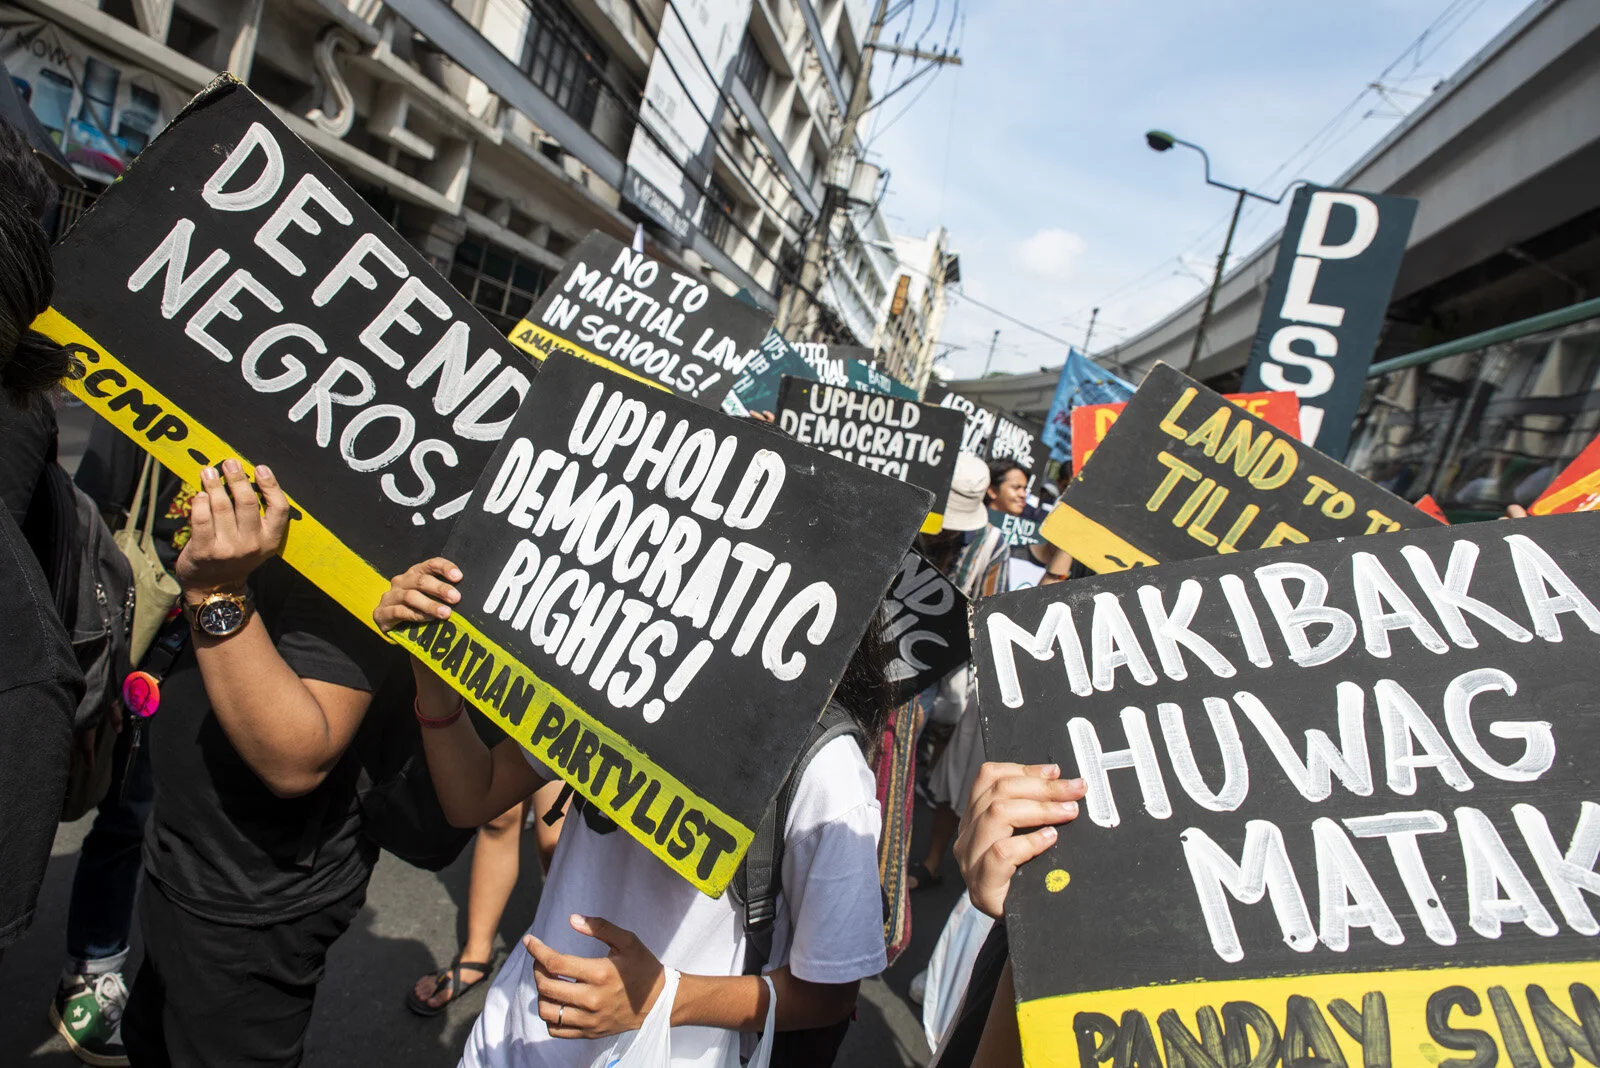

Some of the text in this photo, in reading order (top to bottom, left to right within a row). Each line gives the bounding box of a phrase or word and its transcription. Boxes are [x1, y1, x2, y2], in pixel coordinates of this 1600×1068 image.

[201, 122, 531, 442] DEFEND
[541, 294, 580, 331] IN
[576, 315, 721, 398] SCHOOLS!
[564, 262, 684, 346] MARTIAL
[692, 328, 755, 375] LAW
[611, 247, 709, 313] NO TO
[127, 218, 472, 525] NEGROS!
[780, 408, 945, 467] DEMOCRATIC
[810, 383, 920, 429] UPHOLD
[567, 382, 787, 530] UPHOLD
[1002, 514, 1036, 537] END
[1160, 387, 1299, 490] LAND
[1302, 475, 1356, 520] TO
[482, 437, 838, 681] DEMOCRATIC
[482, 538, 714, 724] RIGHTS!
[987, 534, 1600, 709] MAKIBAKA
[530, 702, 738, 881] PARTYLIST
[1066, 668, 1557, 828] HUWAG
[1180, 801, 1600, 963] MATAK
[1073, 983, 1600, 1068] PANDAY SIN
